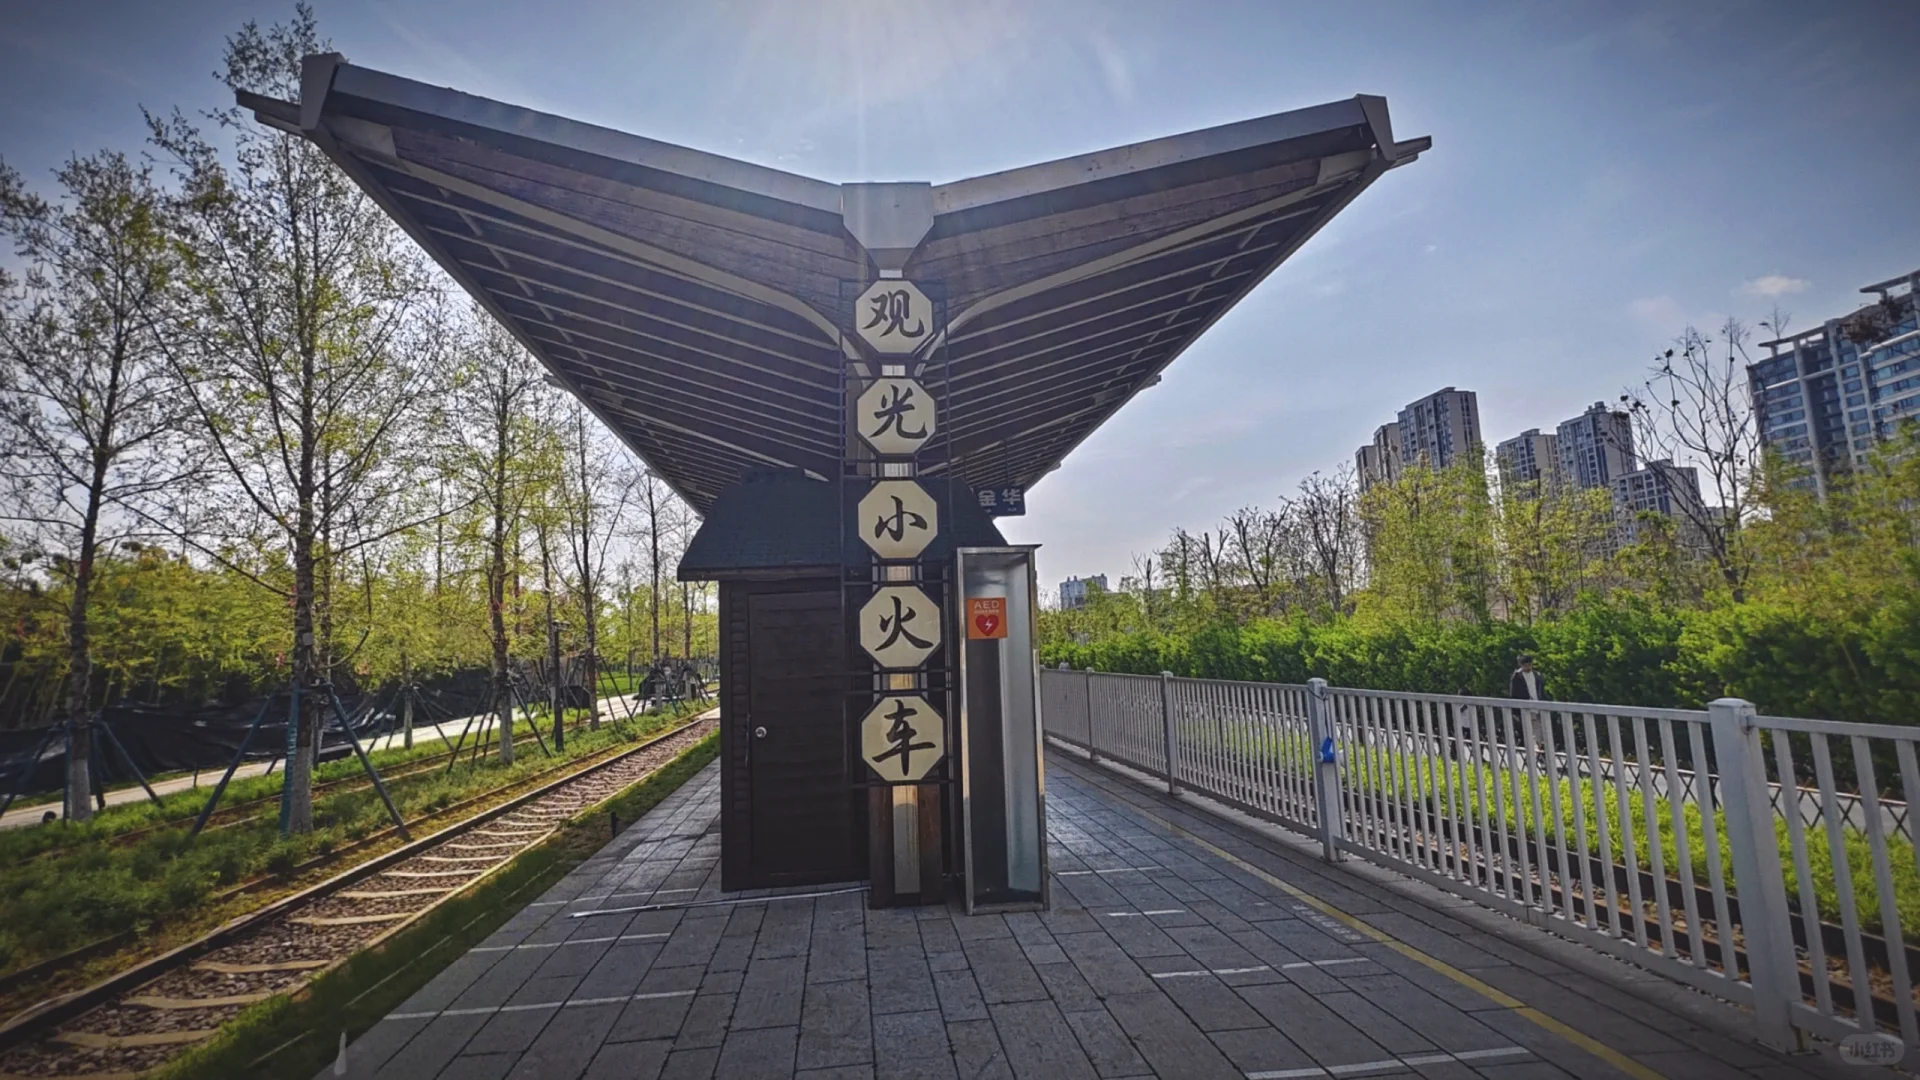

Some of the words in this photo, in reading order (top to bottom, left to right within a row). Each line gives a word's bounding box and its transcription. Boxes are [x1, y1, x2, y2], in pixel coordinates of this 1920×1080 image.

[971, 488, 1021, 506] 金华
[861, 289, 936, 776] 观光小火车
[974, 600, 1000, 609] AED
